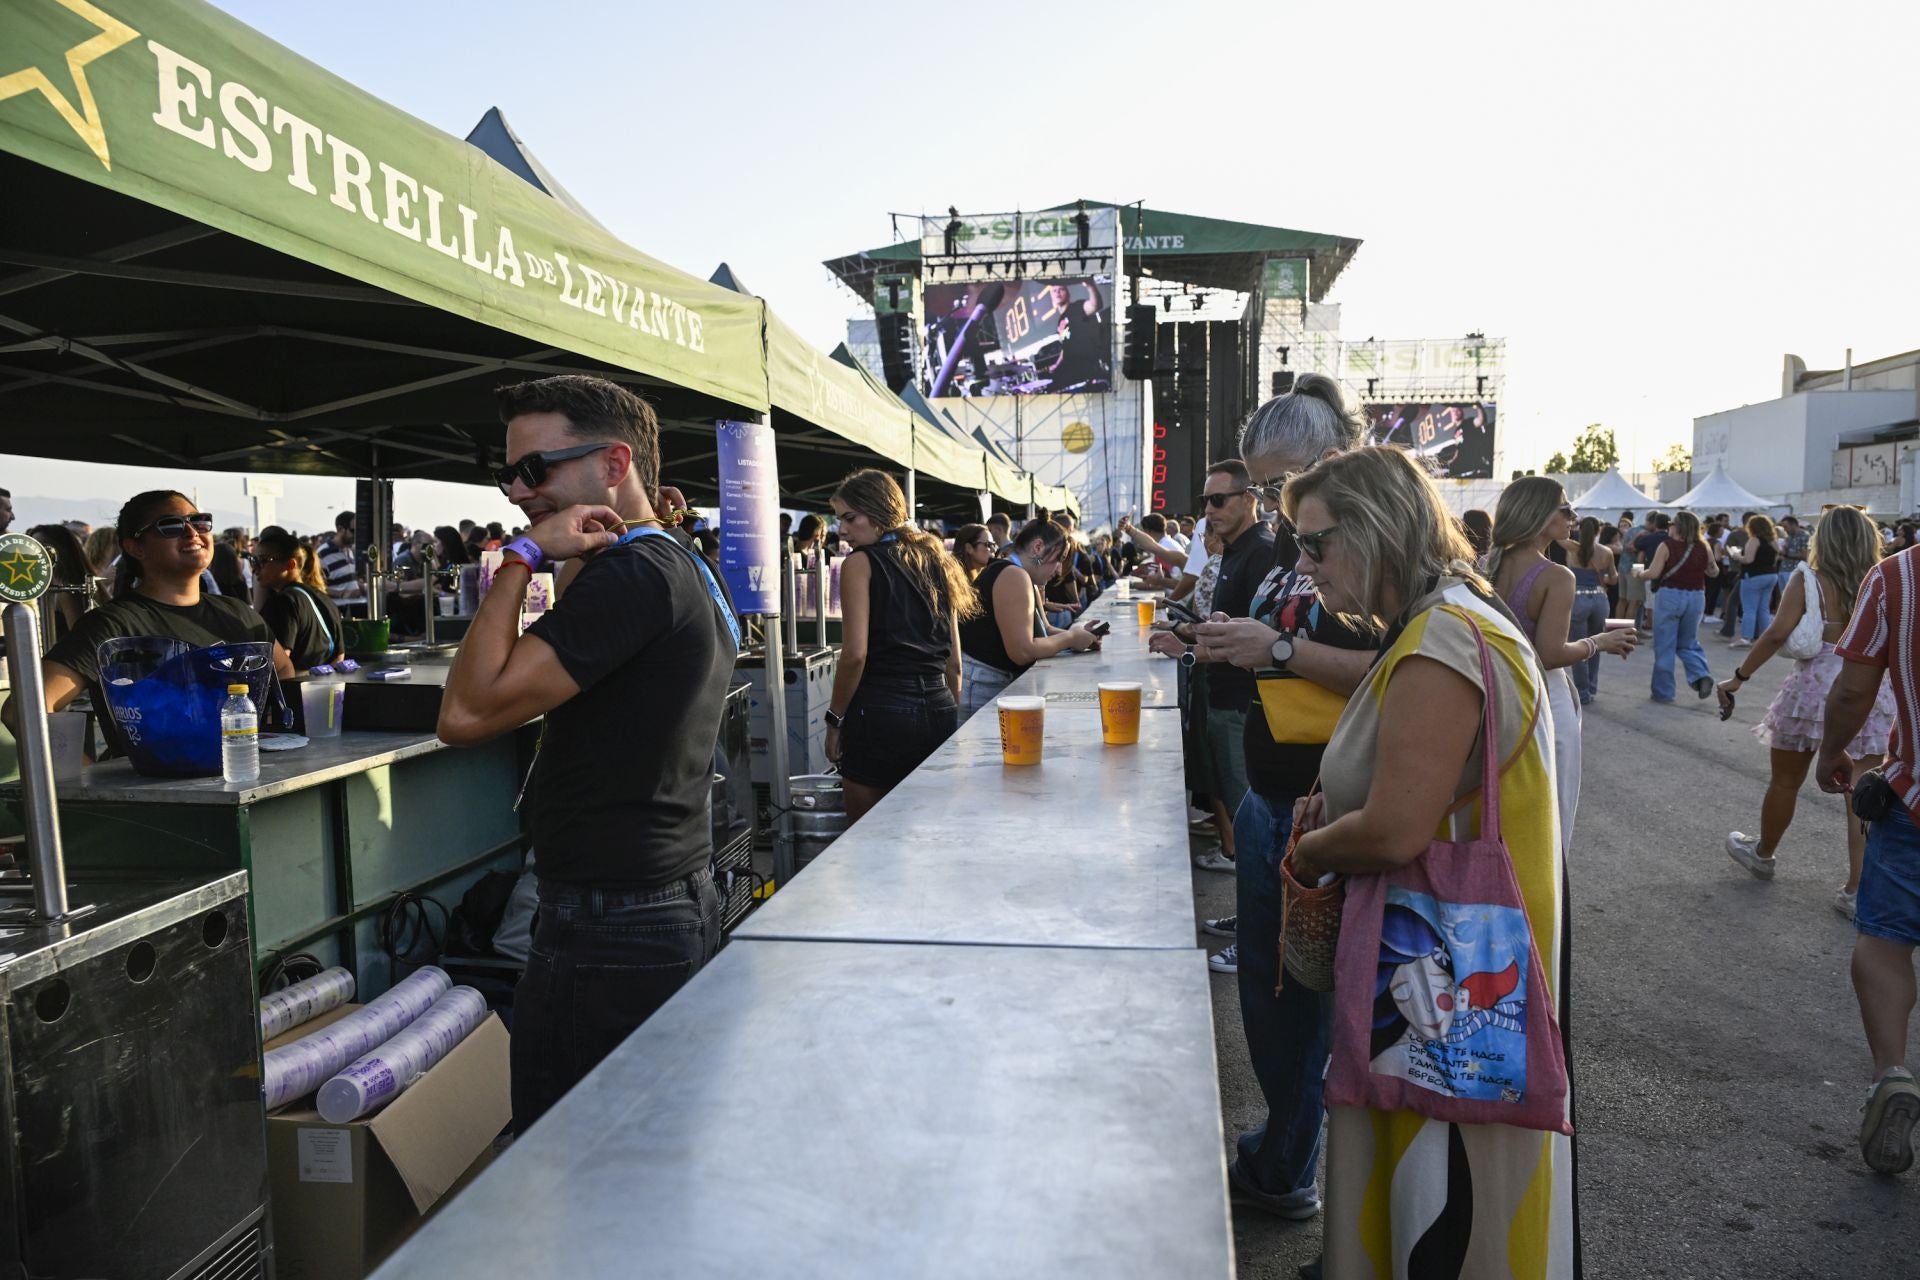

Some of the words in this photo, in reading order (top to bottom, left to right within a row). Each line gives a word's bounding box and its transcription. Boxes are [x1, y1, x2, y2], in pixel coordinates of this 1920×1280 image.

[146, 38, 525, 288] ESTRELLA
[526, 250, 558, 286] DE
[557, 253, 706, 354] LEVANTE
[0, 581, 27, 597] DESDE
[1409, 1033, 1424, 1043] LO
[1426, 1039, 1450, 1053] QUE
[1453, 1047, 1467, 1057] TE
[1470, 1049, 1505, 1062] HACE
[1409, 1044, 1469, 1068] DIFERENTE
[1460, 1072, 1476, 1081] TE
[1478, 1074, 1513, 1086] HACE
